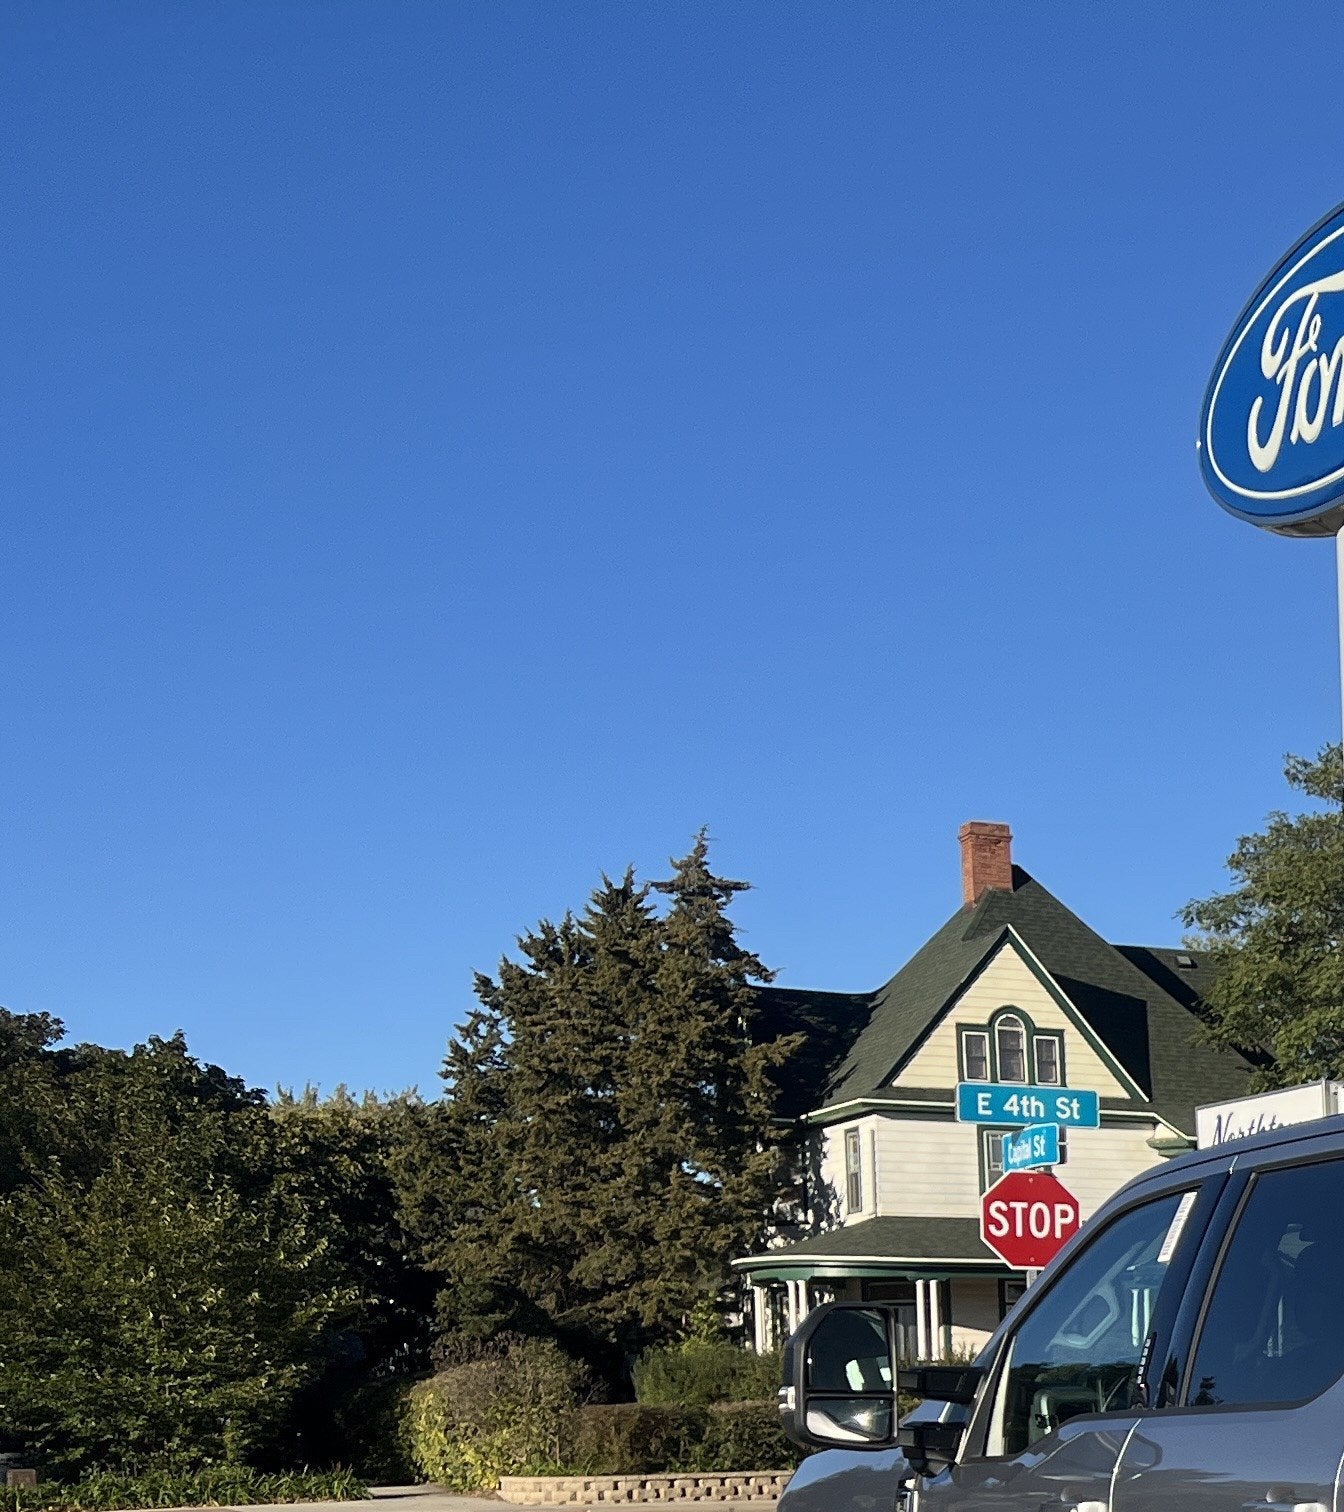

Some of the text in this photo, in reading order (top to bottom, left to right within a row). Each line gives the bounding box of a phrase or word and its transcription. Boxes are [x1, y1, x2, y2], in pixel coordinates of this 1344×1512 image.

[977, 1092, 1081, 1120] E 4th St
[1033, 1134, 1046, 1158] St
[988, 1200, 1075, 1239] STOP
